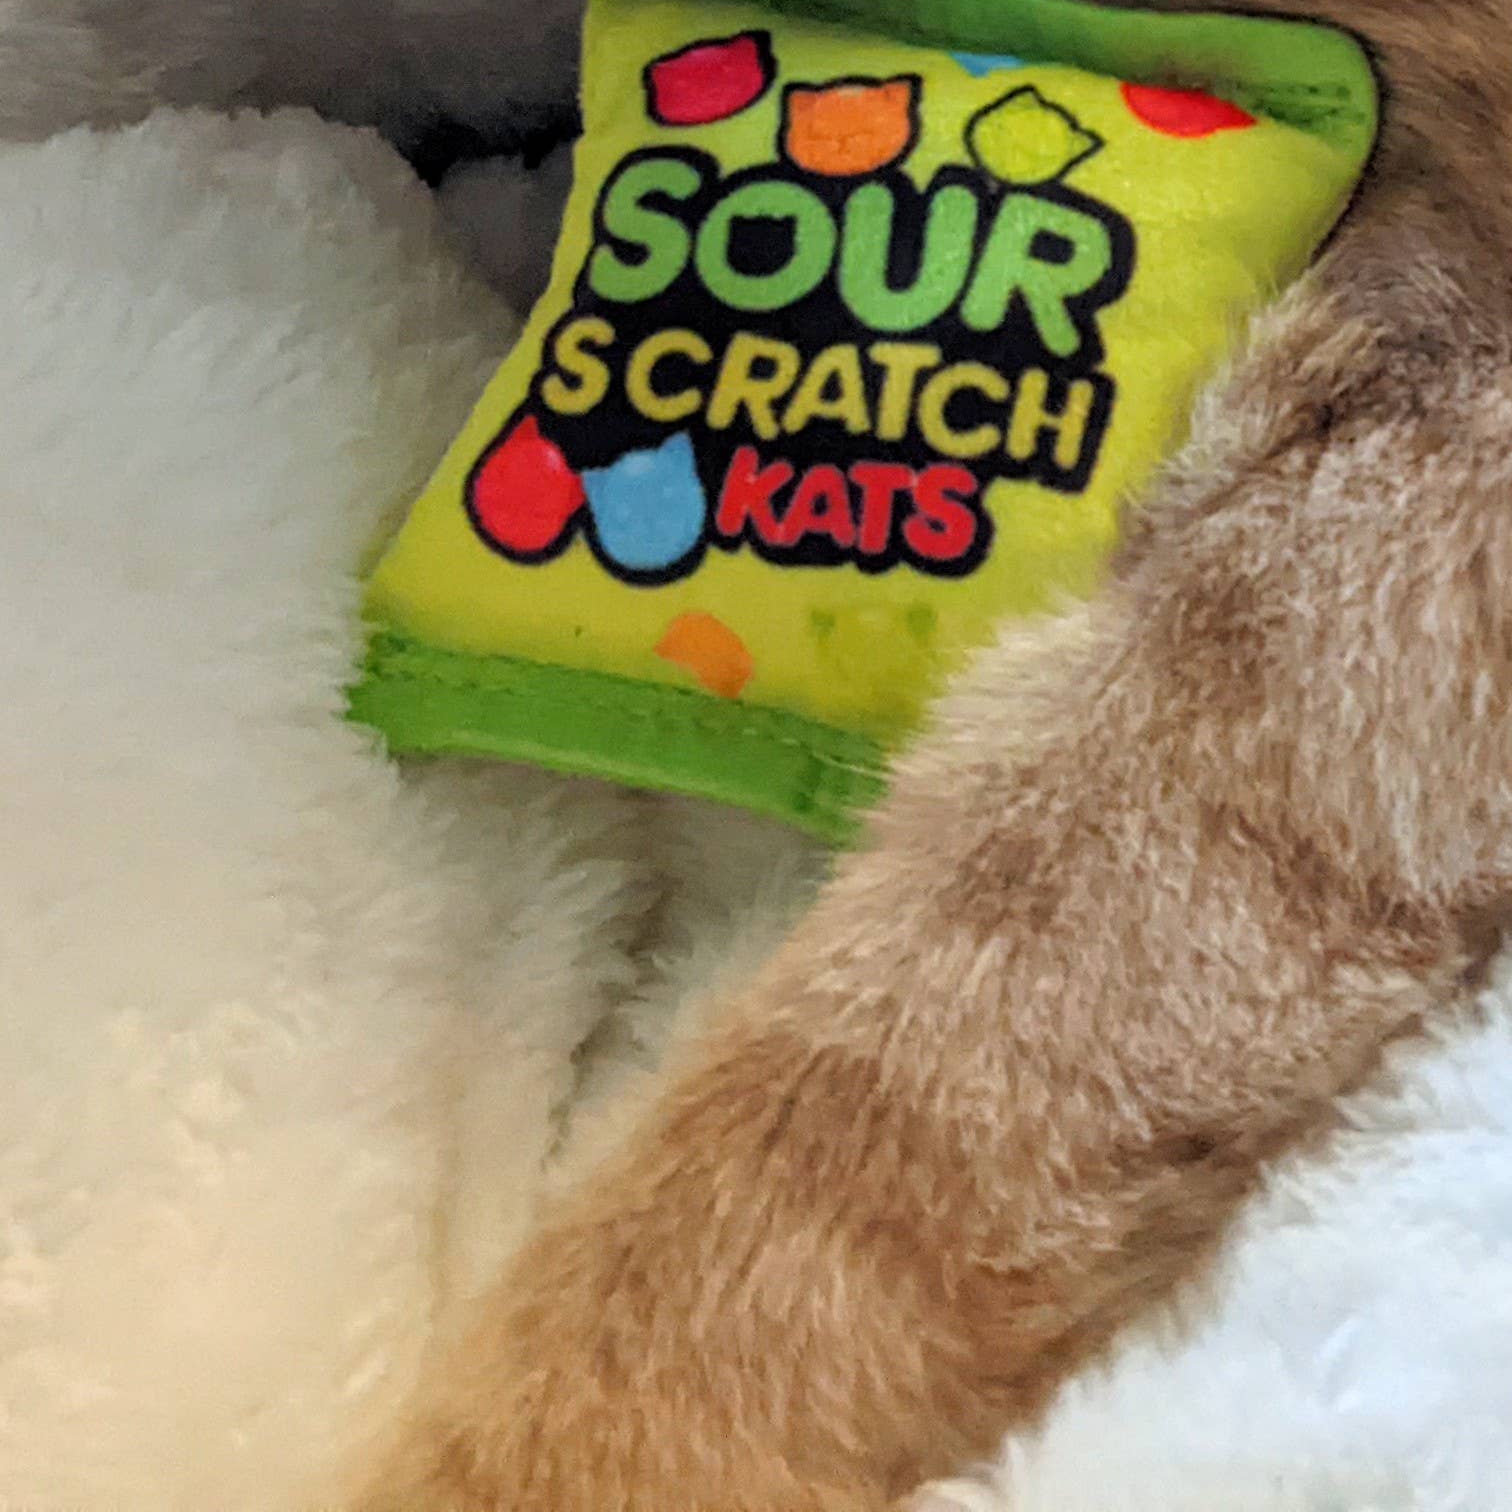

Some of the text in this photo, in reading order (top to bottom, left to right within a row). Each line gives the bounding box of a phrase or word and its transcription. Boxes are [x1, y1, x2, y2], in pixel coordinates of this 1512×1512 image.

[588, 157, 1112, 355] SOUR
[541, 317, 1096, 470] SCRATCH
[715, 446, 978, 561] KATS
